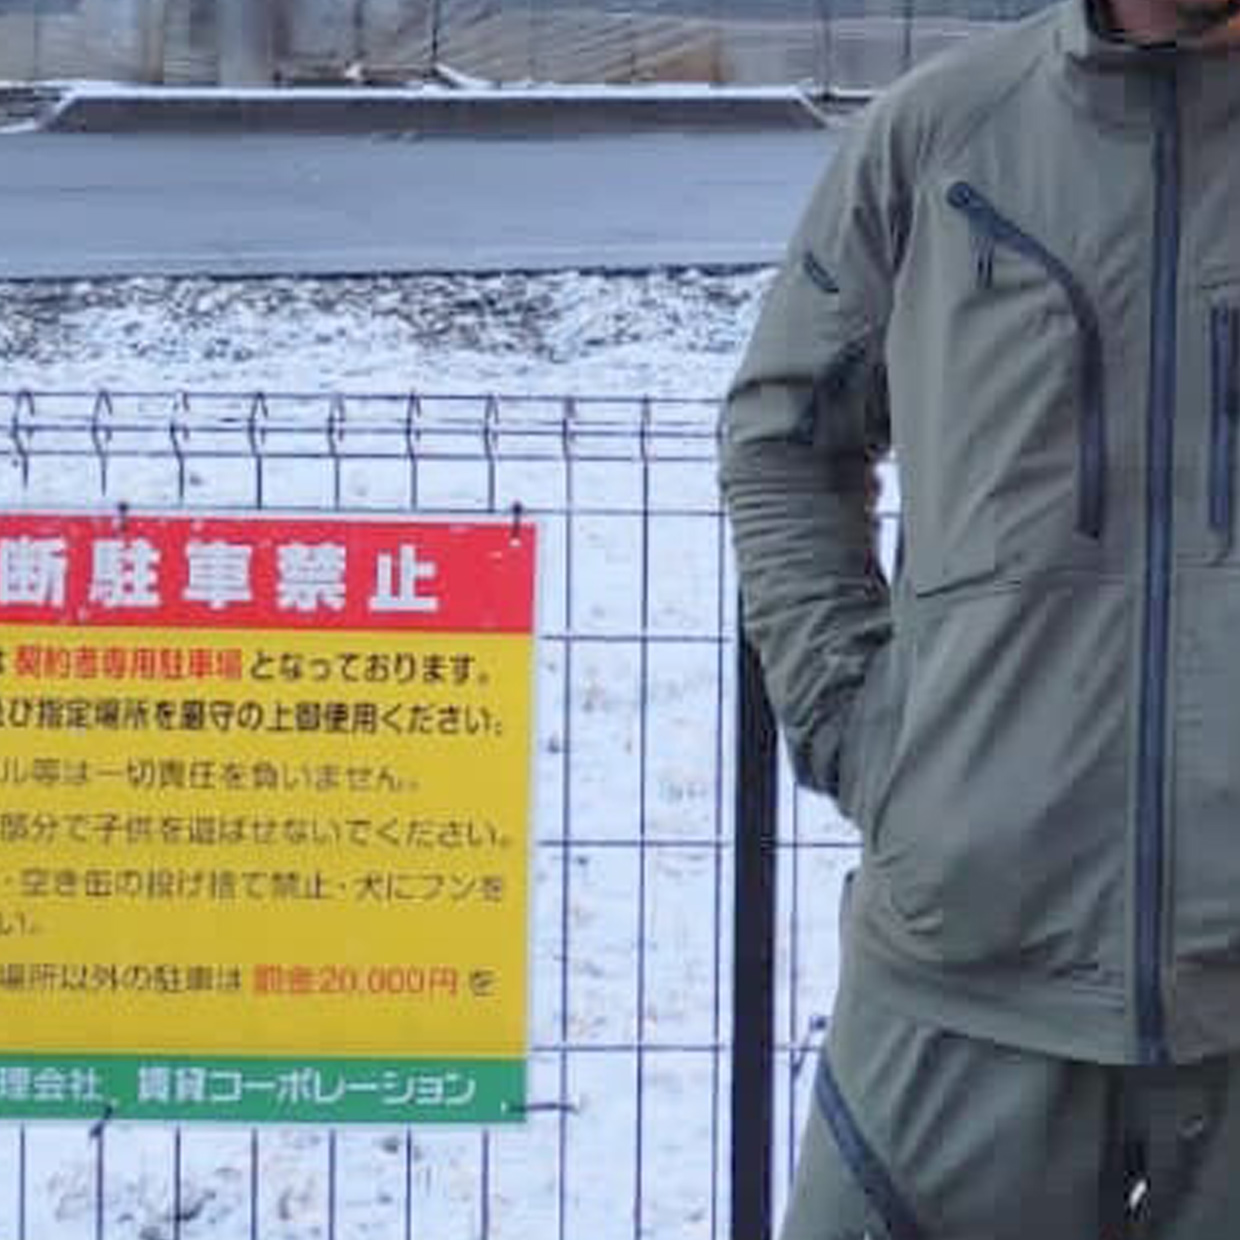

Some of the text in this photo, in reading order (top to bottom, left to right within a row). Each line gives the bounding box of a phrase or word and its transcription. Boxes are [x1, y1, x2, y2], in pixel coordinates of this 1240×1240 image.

[0, 536, 439, 611] 断駐車禁止
[250, 650, 489, 685] となっております。
[0, 697, 502, 736] び指定場所を厳守の上御使用ください。
[470, 968, 496, 997] を
